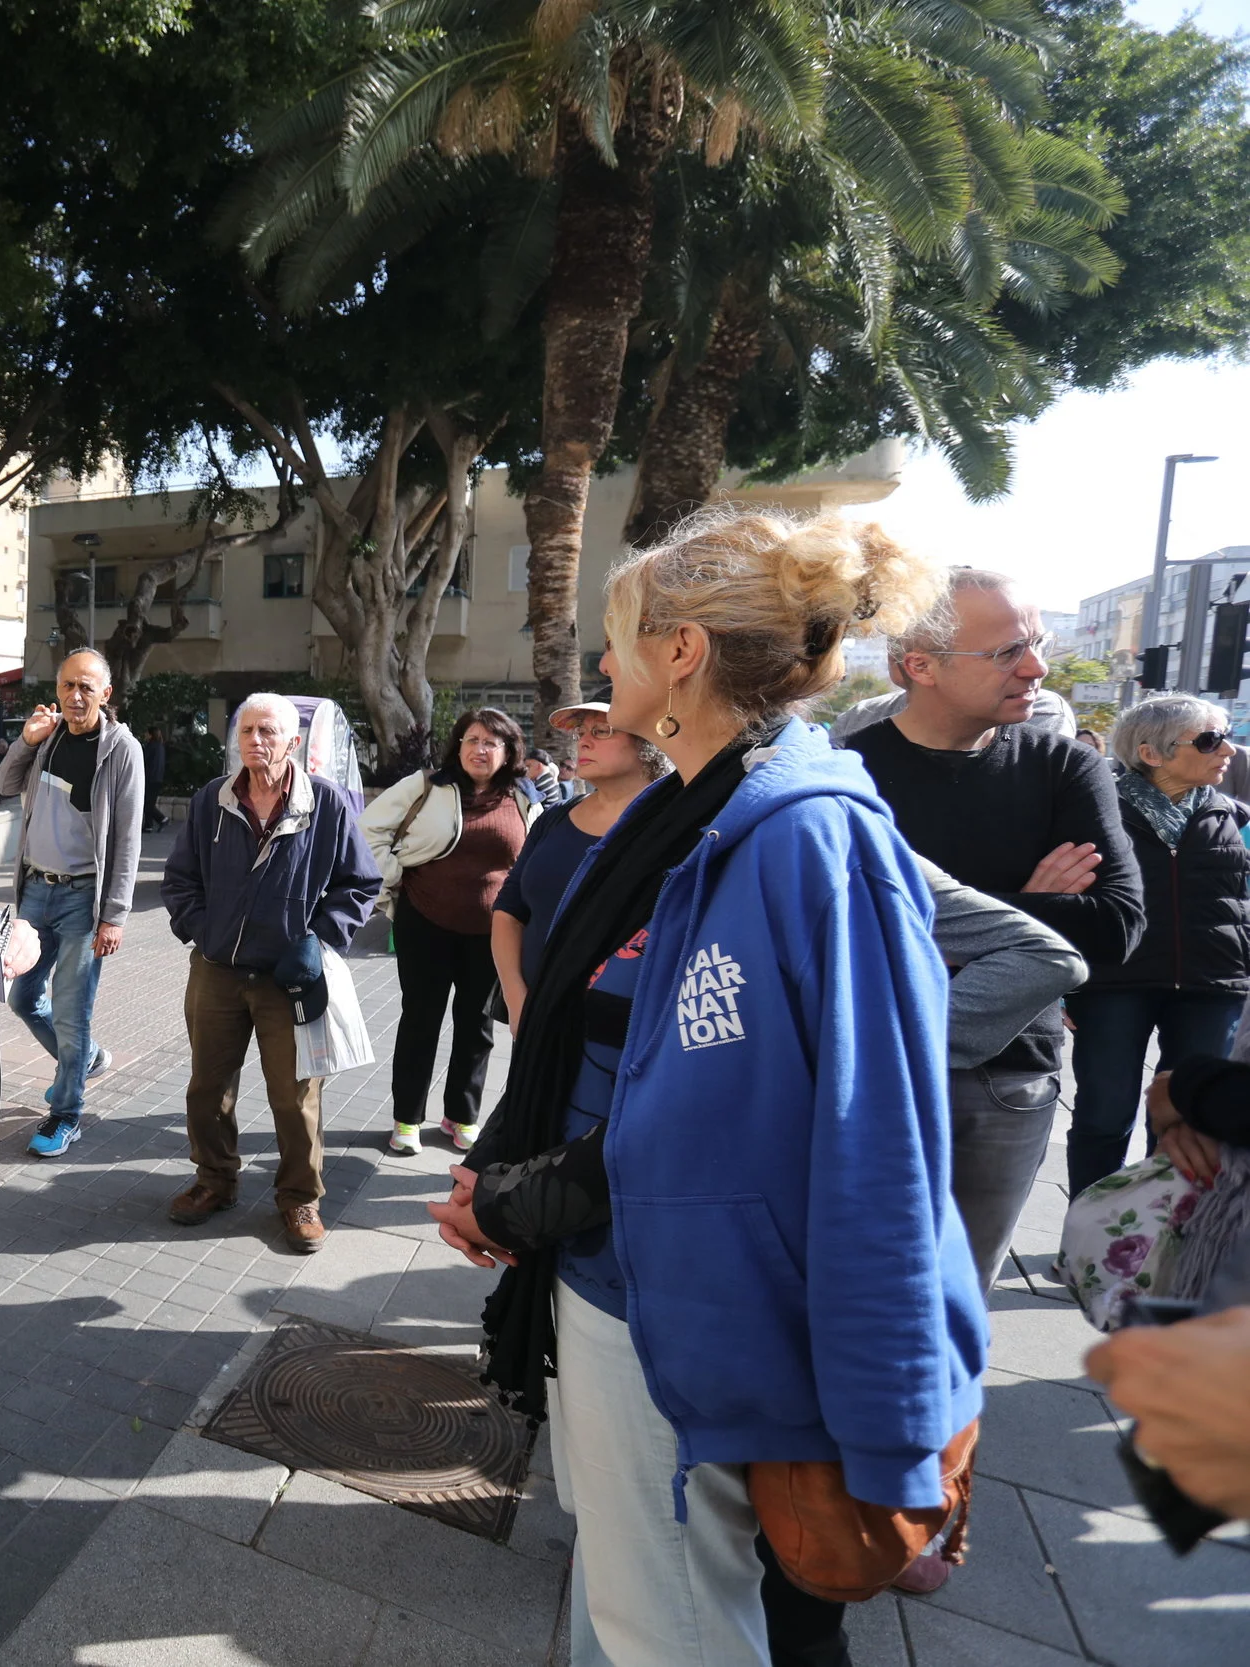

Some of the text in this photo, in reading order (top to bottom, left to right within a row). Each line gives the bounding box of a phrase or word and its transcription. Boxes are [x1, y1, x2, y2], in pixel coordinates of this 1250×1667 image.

[677, 962, 748, 1003] MAR
[677, 986, 741, 1025] NAT
[678, 1011, 746, 1048] ION
